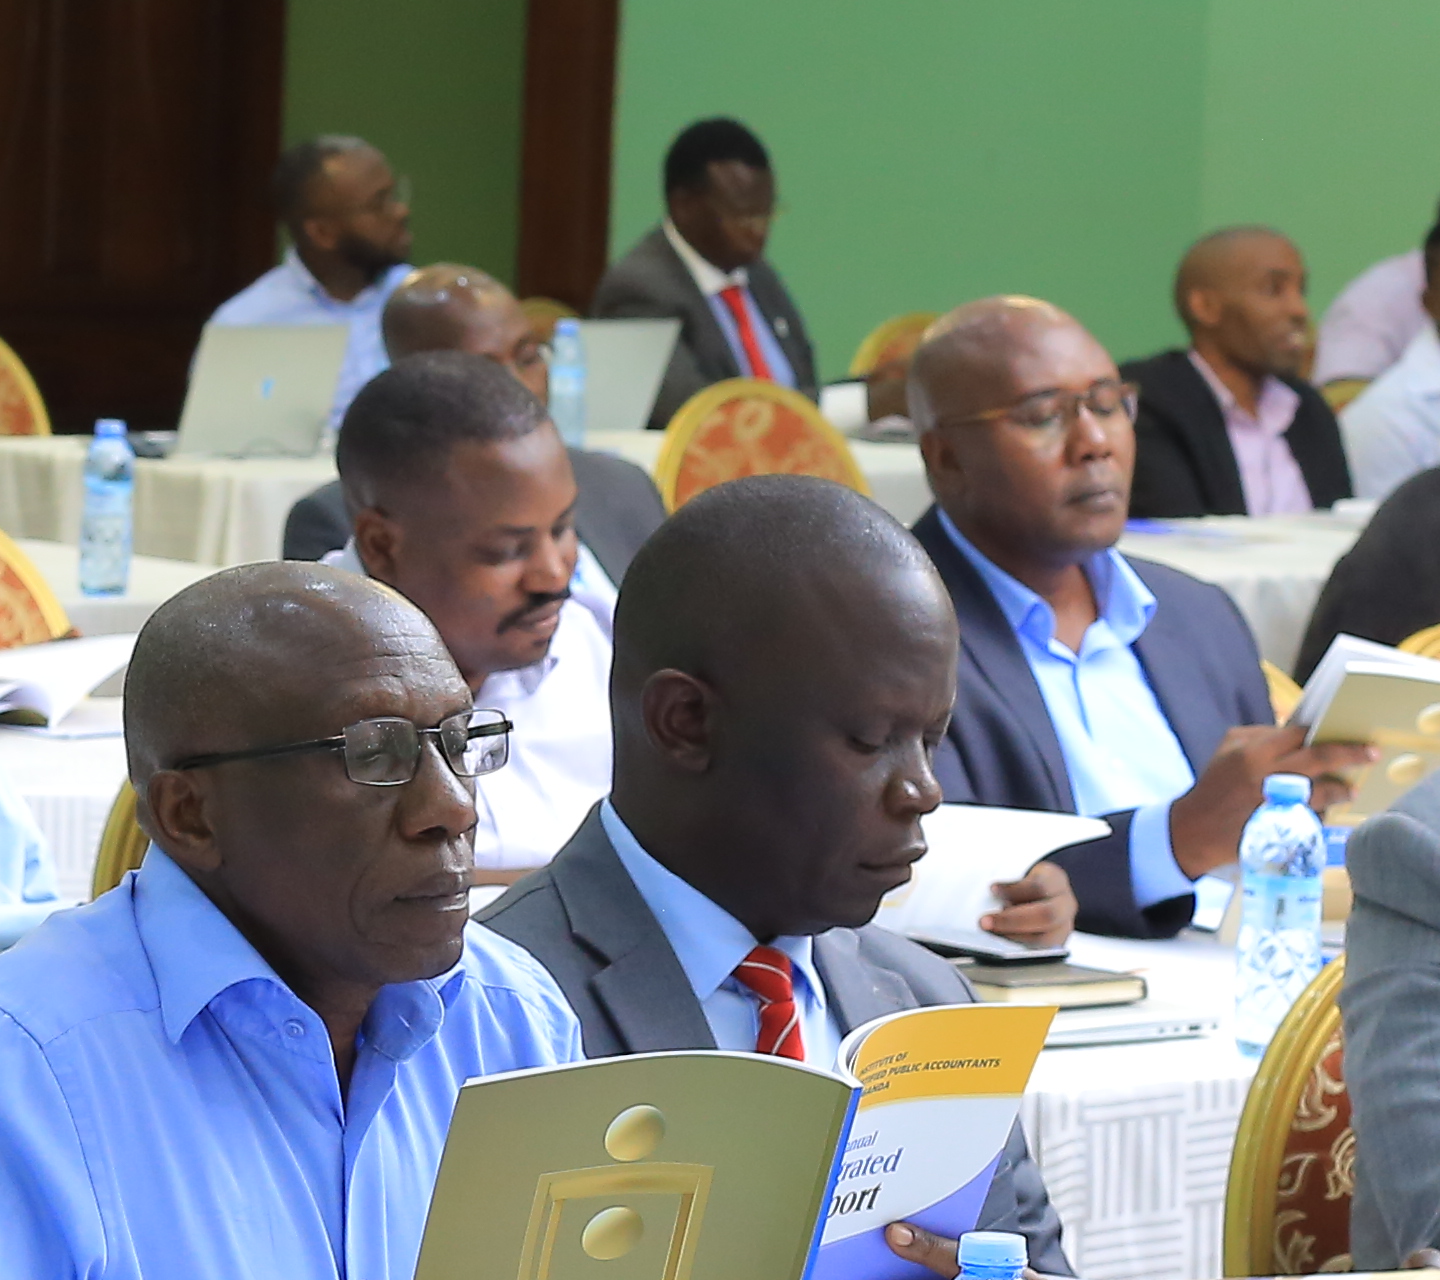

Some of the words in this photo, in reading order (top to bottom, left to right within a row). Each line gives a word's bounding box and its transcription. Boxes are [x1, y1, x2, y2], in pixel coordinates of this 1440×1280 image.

[895, 1052, 909, 1063] OF
[888, 1063, 922, 1077] PUBLIC
[922, 1058, 1001, 1072] ACCOUNTANTS
[839, 1147, 904, 1181] rated
